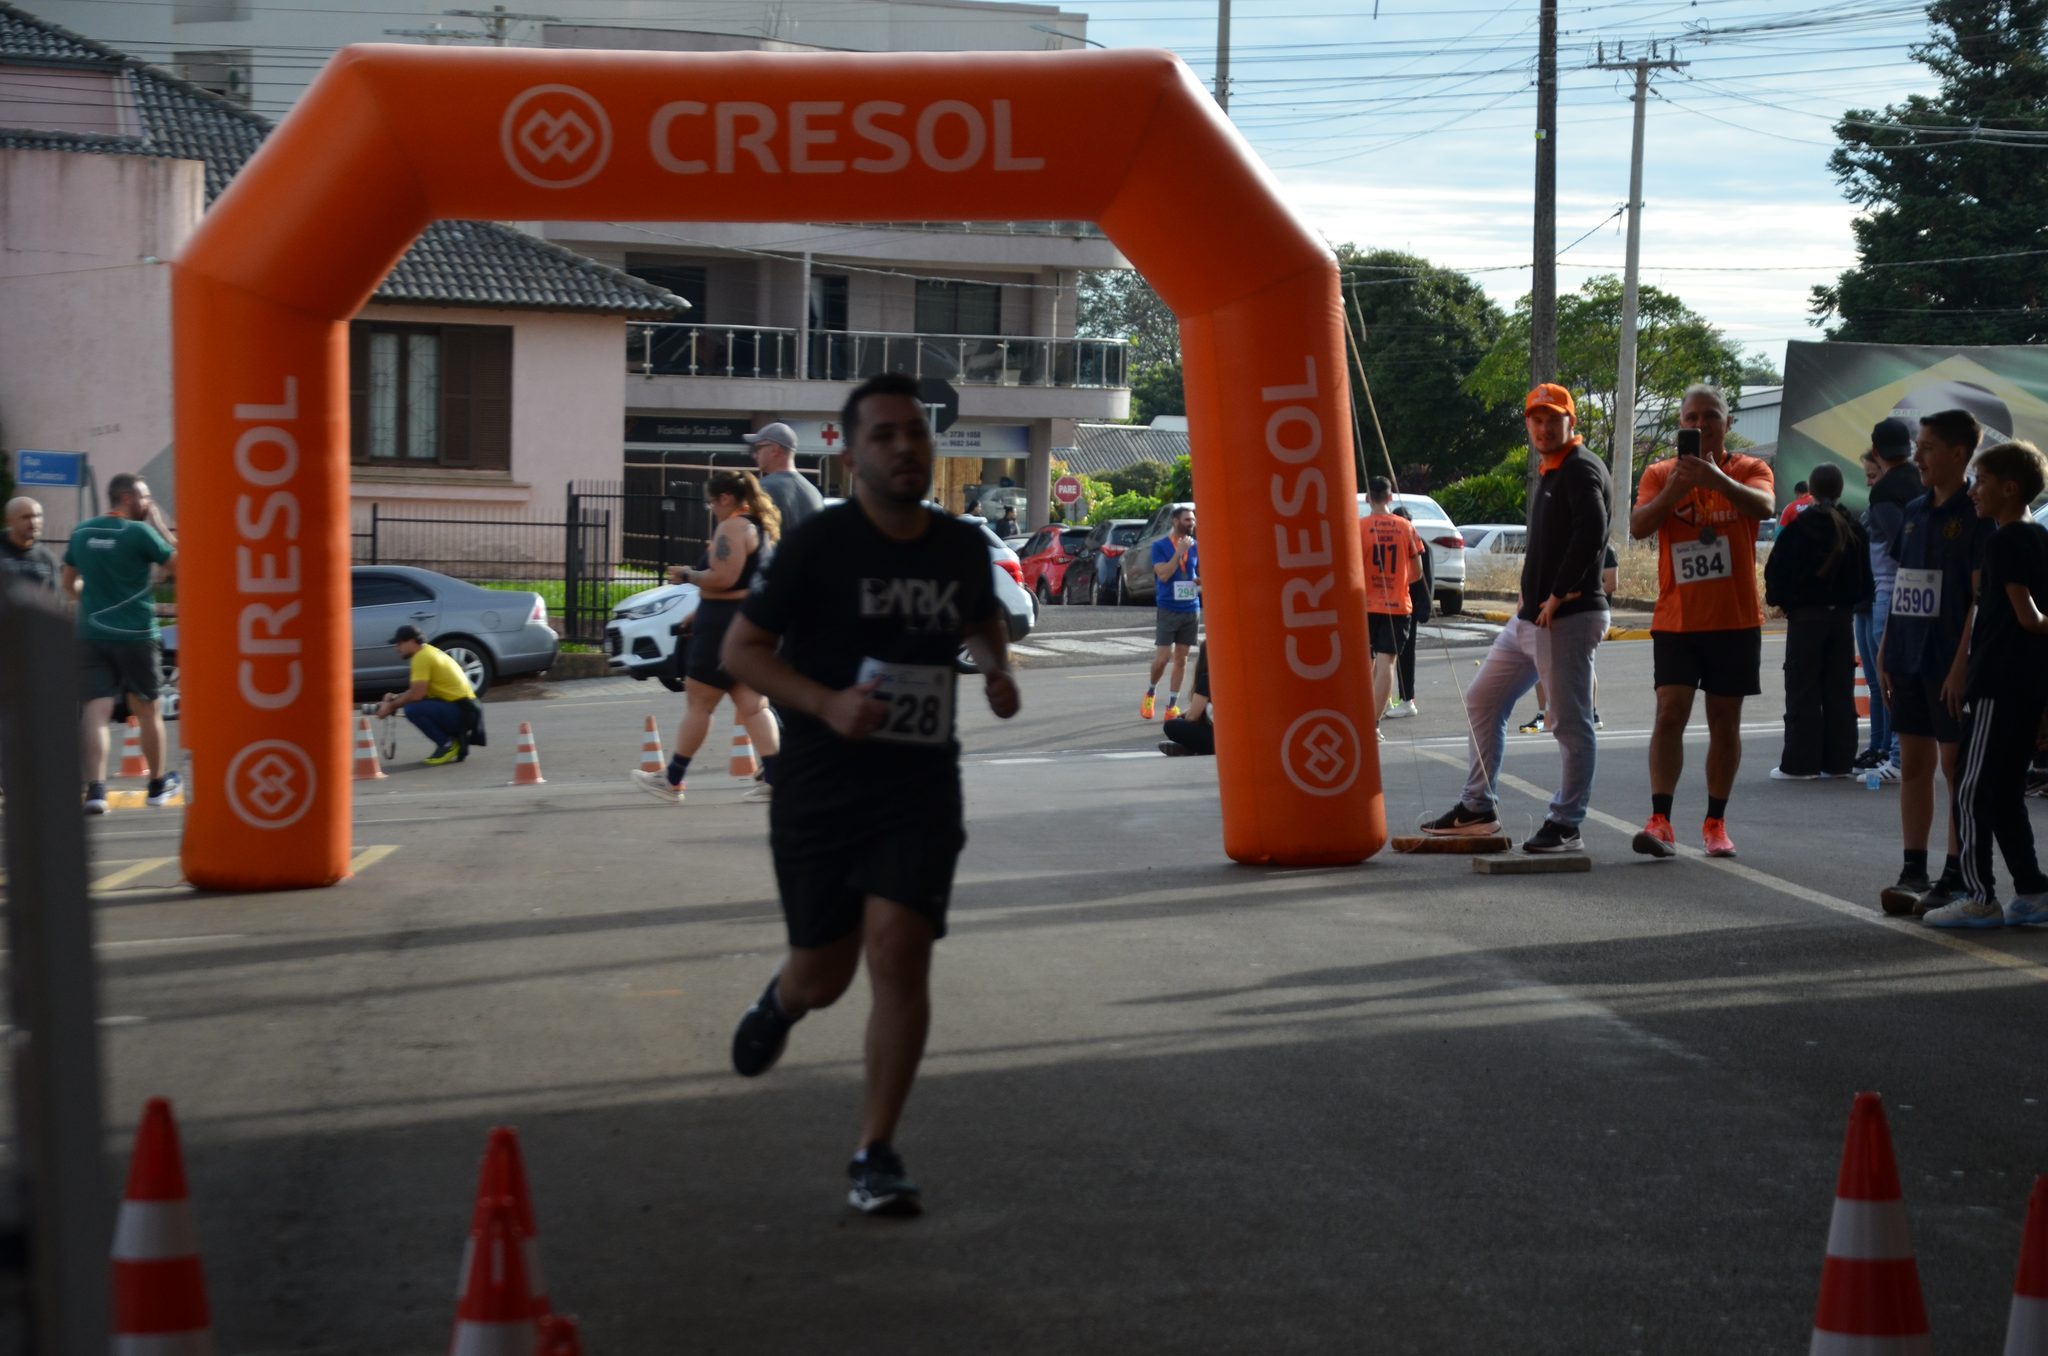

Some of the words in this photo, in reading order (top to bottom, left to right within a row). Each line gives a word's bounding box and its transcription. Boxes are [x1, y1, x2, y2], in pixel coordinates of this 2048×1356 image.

[649, 97, 1046, 175] CRESOL
[1058, 485, 1077, 494] PARE
[1261, 354, 1341, 681] CRESOL
[234, 375, 303, 711] CRESOL
[1372, 543, 1397, 574] 41
[1682, 552, 1724, 579] 584
[1177, 588, 1195, 598] 294
[1894, 587, 1935, 614] 2590
